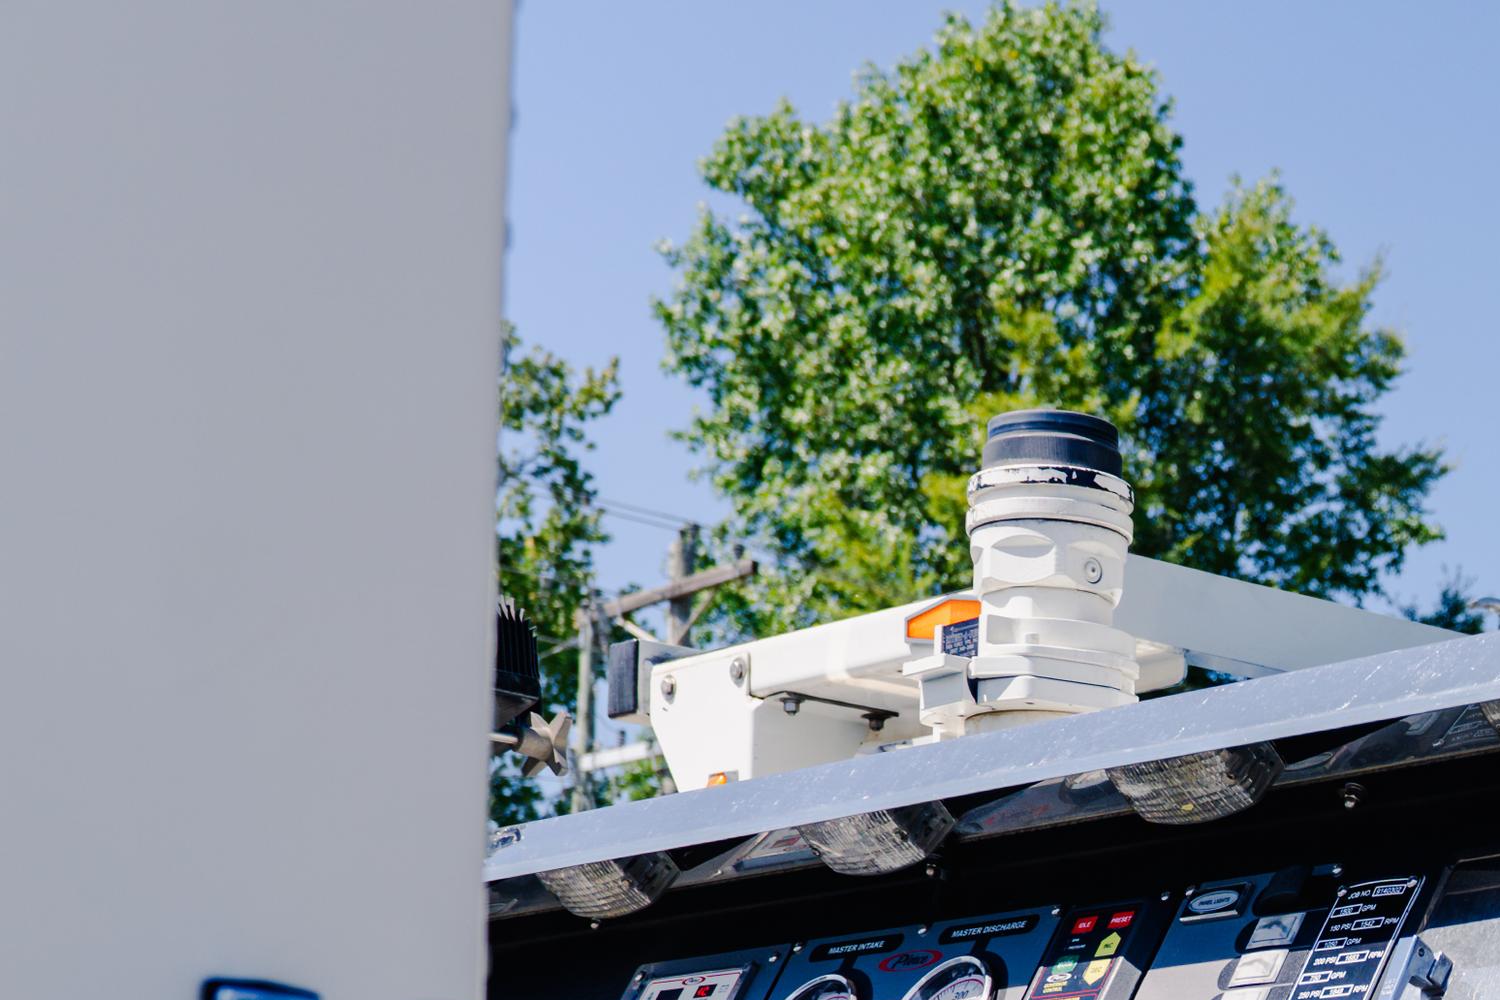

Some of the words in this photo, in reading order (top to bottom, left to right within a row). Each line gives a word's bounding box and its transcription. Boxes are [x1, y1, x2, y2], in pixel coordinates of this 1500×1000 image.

[1347, 891, 1361, 900] JOB
[1361, 904, 1377, 912] GPM
[1110, 915, 1133, 924] PRESET
[1340, 923, 1352, 931] PSI
[1384, 917, 1400, 925] RPM
[951, 926, 982, 938] MASTER
[983, 920, 1028, 934] DISCHARGE
[1078, 921, 1092, 929] IDLE
[1347, 937, 1362, 946] GPM
[828, 943, 858, 955] MASTER
[858, 940, 885, 952] INTAKE
[1325, 956, 1337, 964] PSI
[1368, 950, 1385, 959] RPM
[1330, 971, 1347, 979] GPM
[952, 990, 970, 1000] 300
[1309, 990, 1321, 998] PSI
[1352, 984, 1369, 993] RPM
